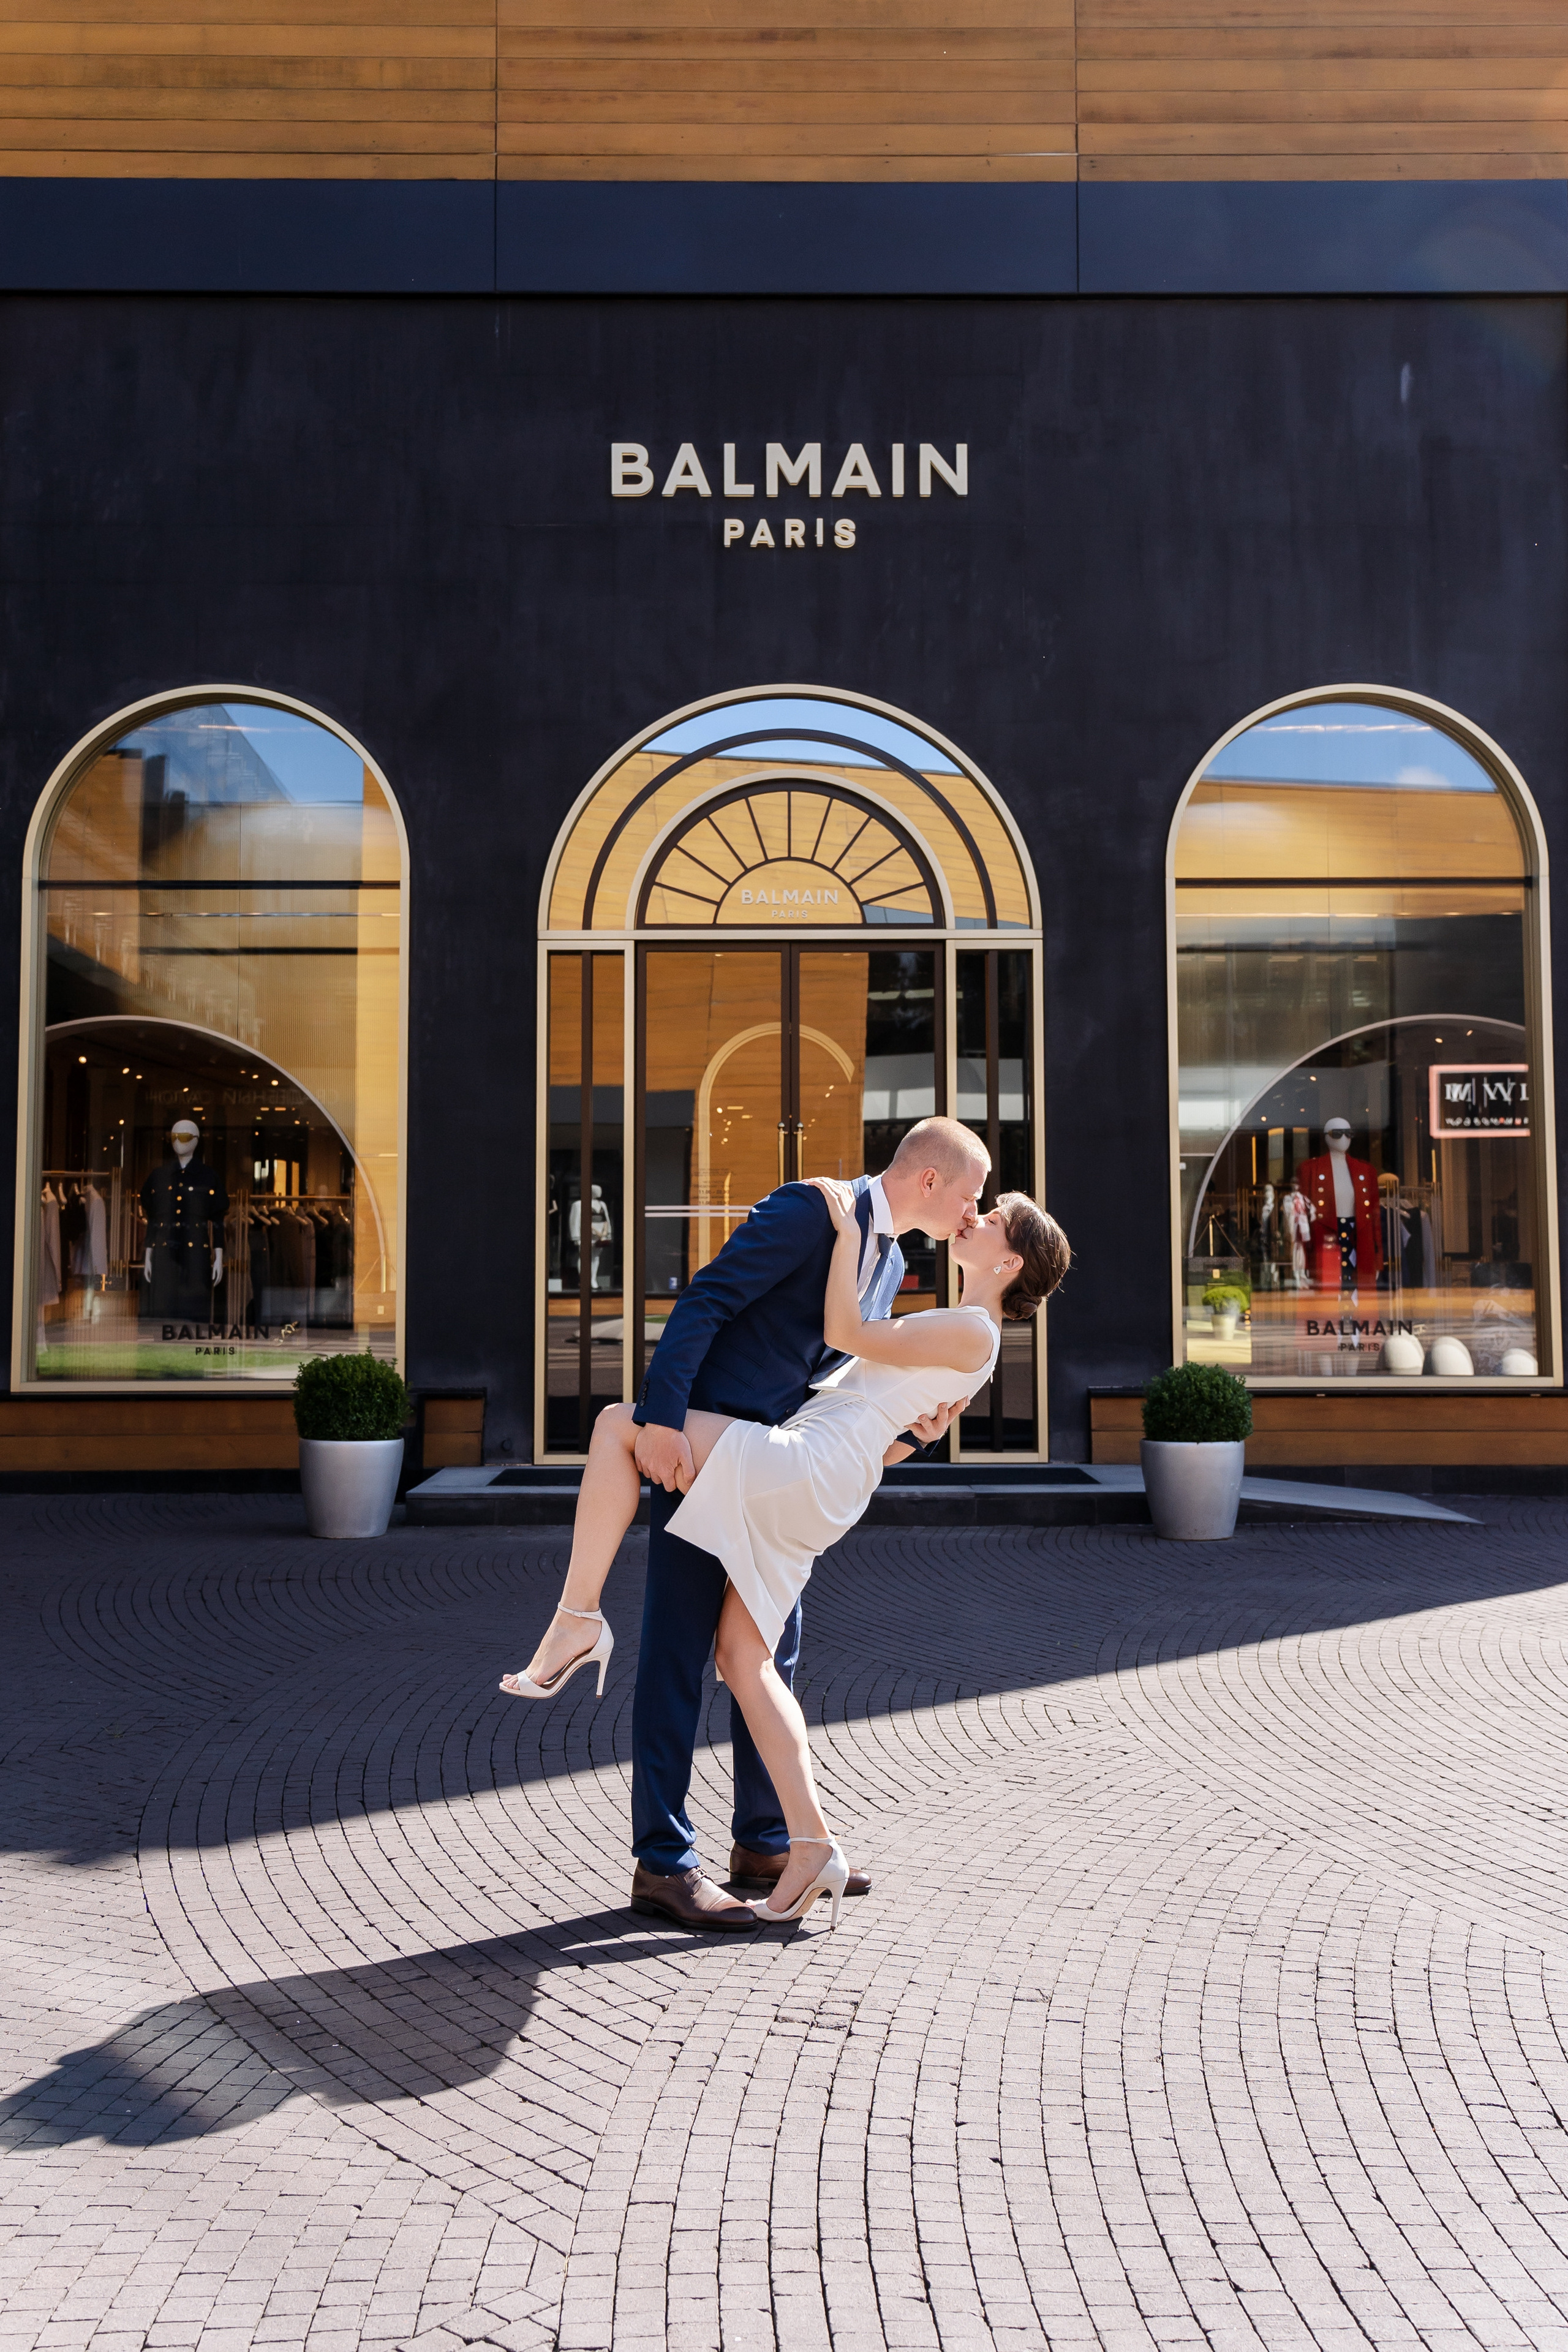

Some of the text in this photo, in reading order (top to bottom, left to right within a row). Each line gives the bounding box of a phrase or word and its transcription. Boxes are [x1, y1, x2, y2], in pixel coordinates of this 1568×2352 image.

[611, 443, 968, 497] BALMAIN
[723, 518, 856, 548] PARIS
[741, 889, 839, 905] BALMAIN
[771, 910, 809, 919] PARIS
[162, 1324, 270, 1340] BALMAIN
[1306, 1320, 1413, 1336] BALMAIN
[195, 1347, 235, 1355] PARIS
[1340, 1343, 1380, 1352] PARIS
